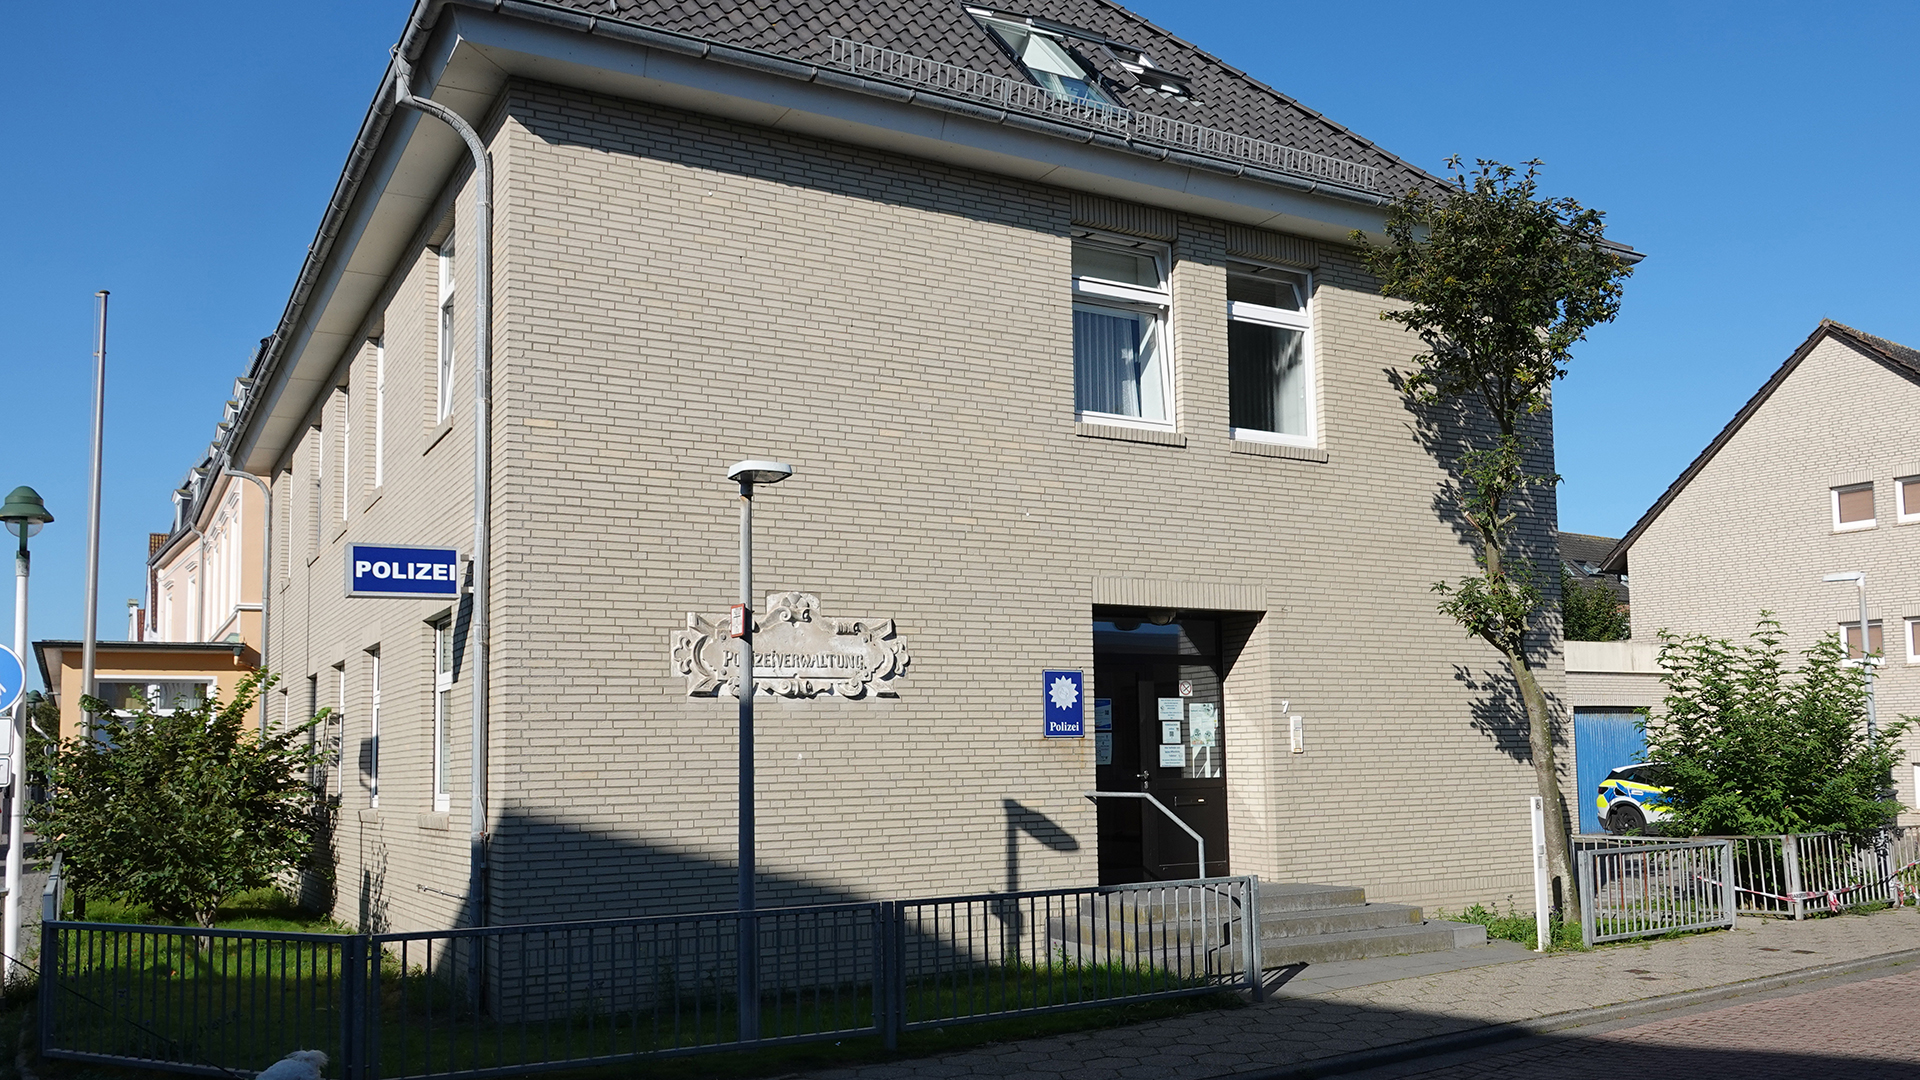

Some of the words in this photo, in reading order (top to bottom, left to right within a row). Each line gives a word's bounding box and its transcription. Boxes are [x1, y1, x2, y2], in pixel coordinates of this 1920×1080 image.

[355, 560, 456, 581] POLIZEI
[1281, 700, 1289, 714] 7
[1049, 721, 1080, 732] Polizei
